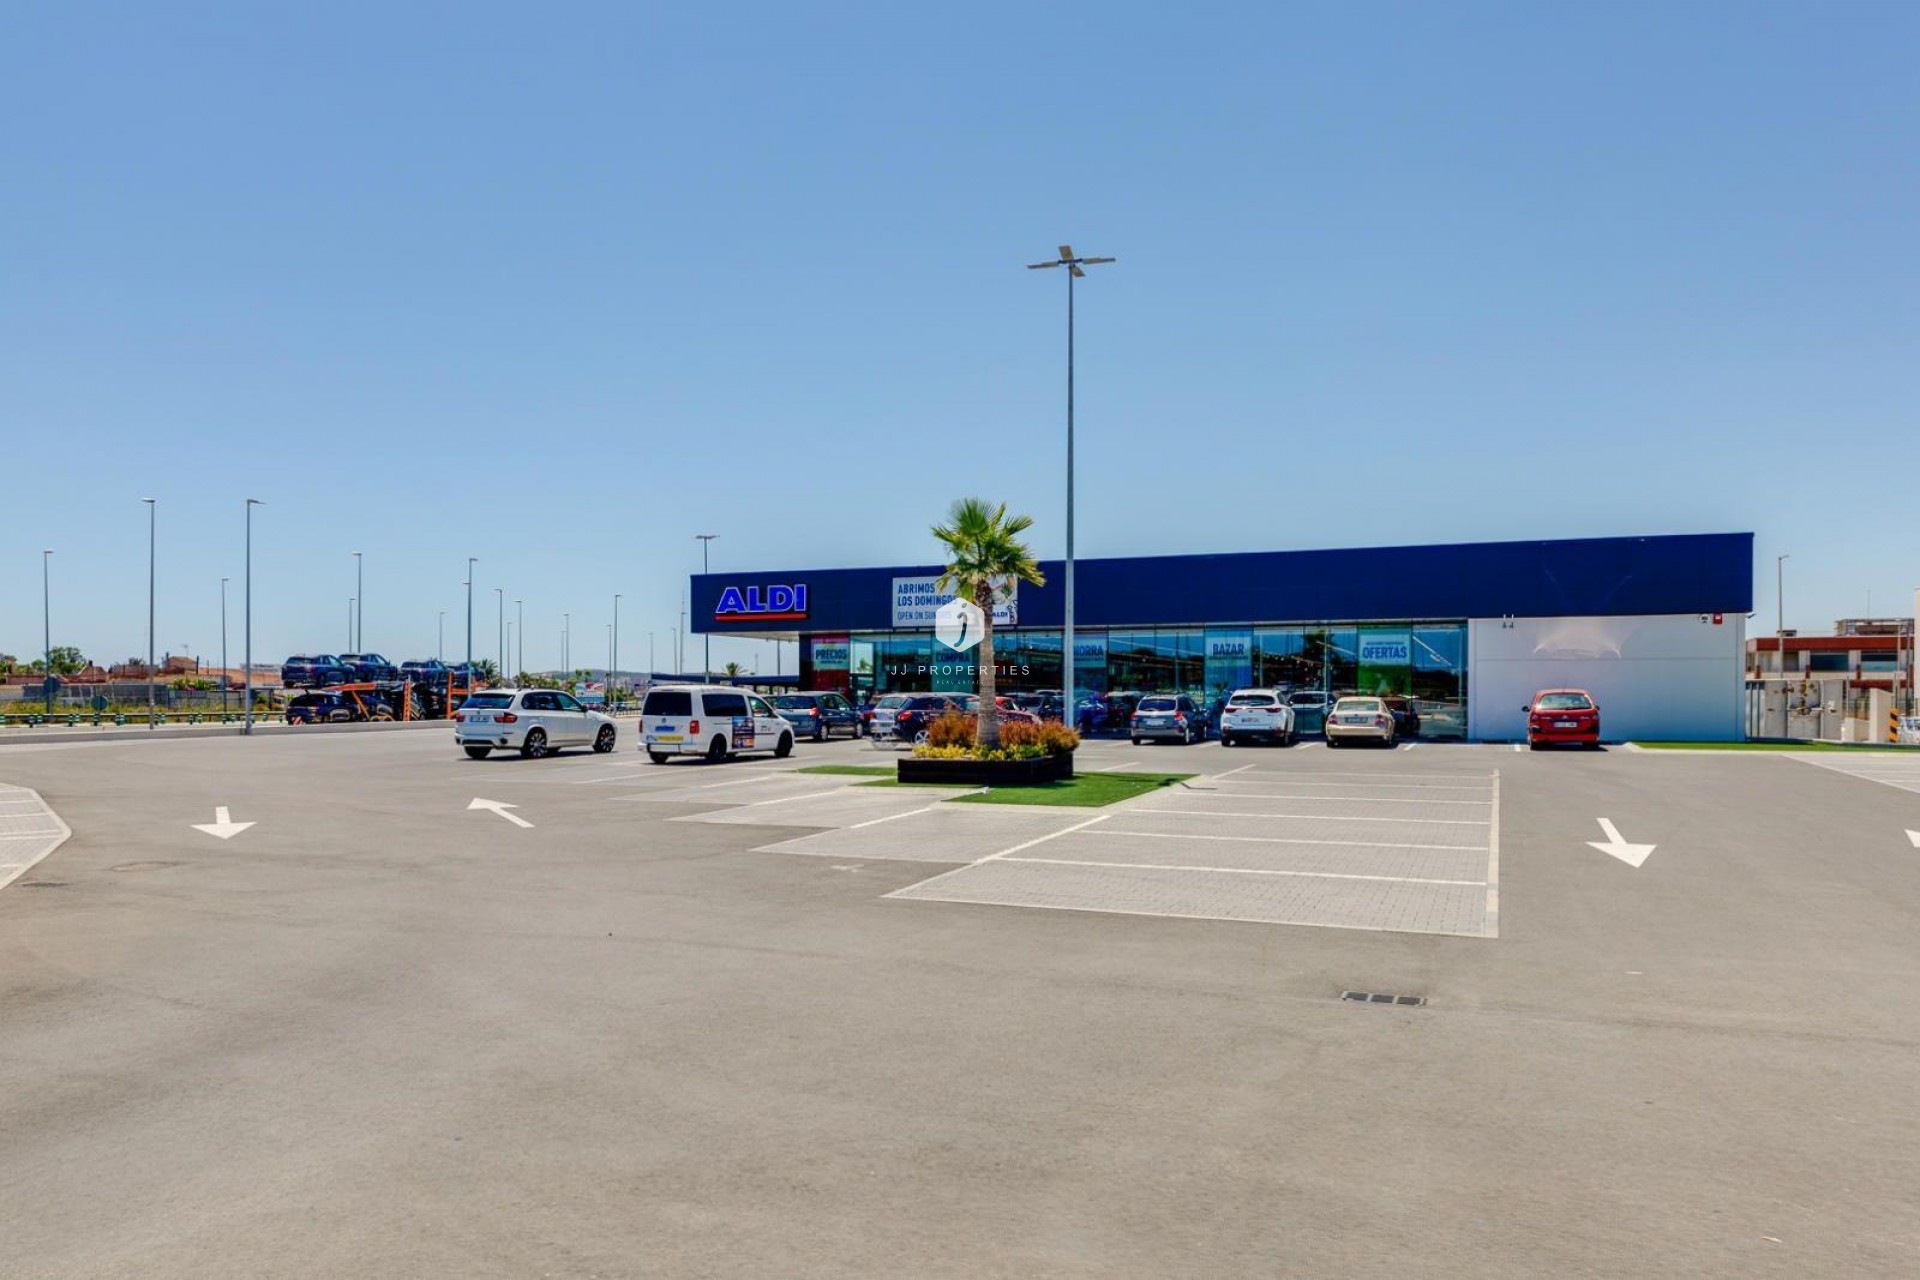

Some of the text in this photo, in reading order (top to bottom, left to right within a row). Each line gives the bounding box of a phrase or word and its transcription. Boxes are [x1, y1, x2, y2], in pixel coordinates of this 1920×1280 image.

[898, 583, 936, 594] ABRIMOS
[715, 584, 807, 613] ALDI
[898, 596, 912, 607] LOS
[815, 649, 848, 660] PRECIOS
[1212, 643, 1245, 656] BAZAR
[1362, 646, 1407, 659] OFERTAS
